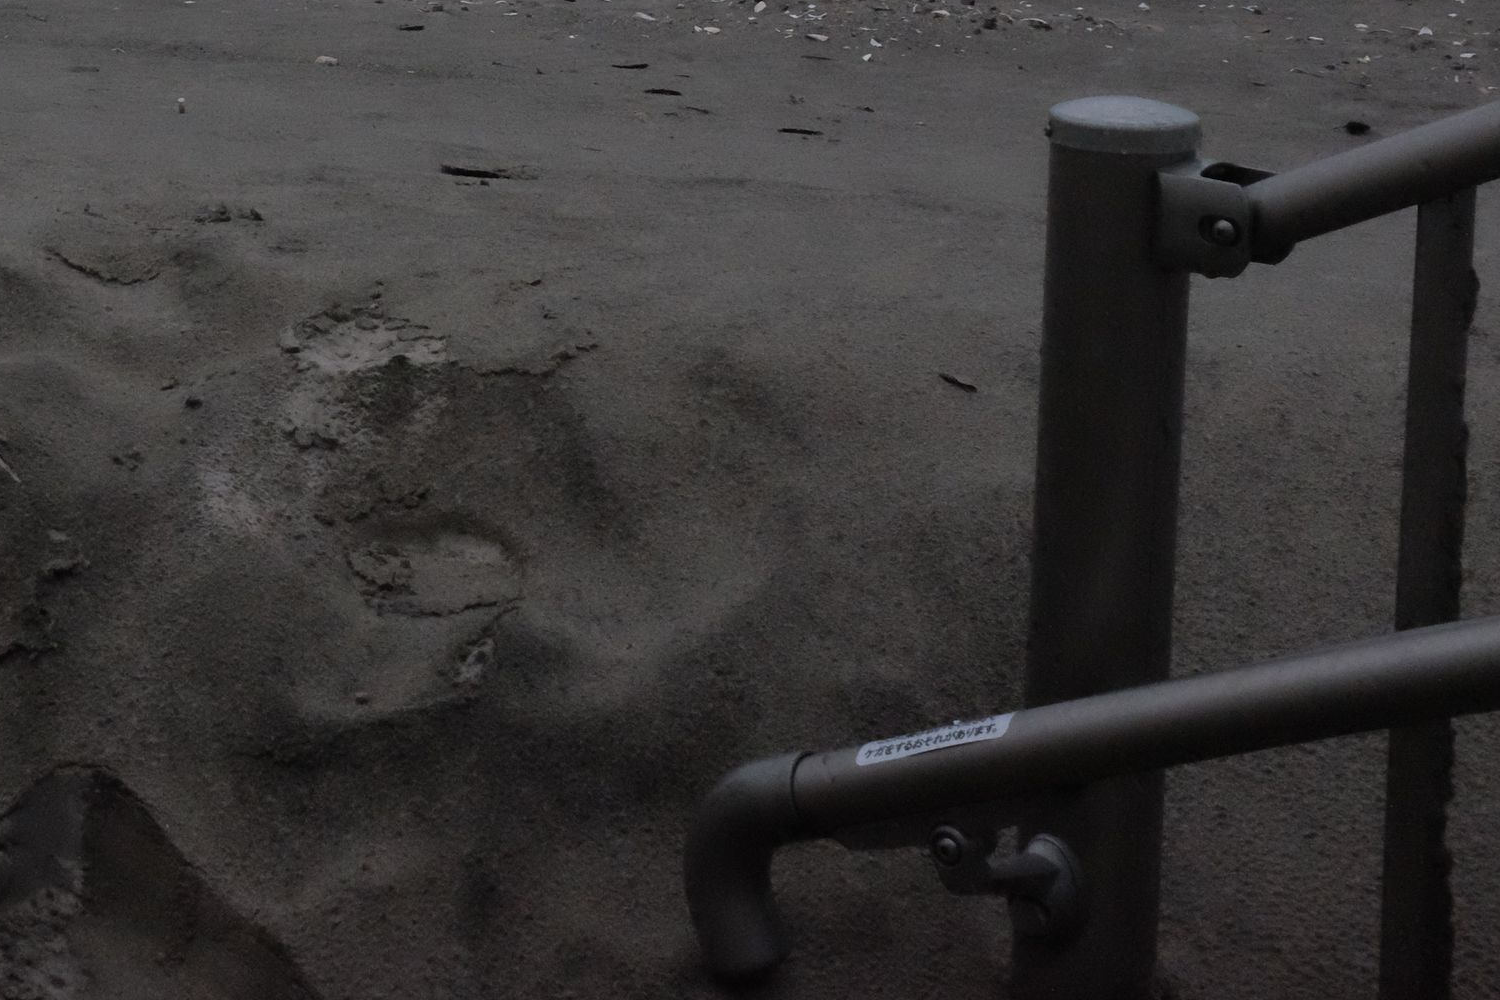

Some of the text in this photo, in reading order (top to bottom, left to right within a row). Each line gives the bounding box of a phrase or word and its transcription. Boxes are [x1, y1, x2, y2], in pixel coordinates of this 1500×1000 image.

[864, 723, 998, 759] ケガをするおそれがあります。
